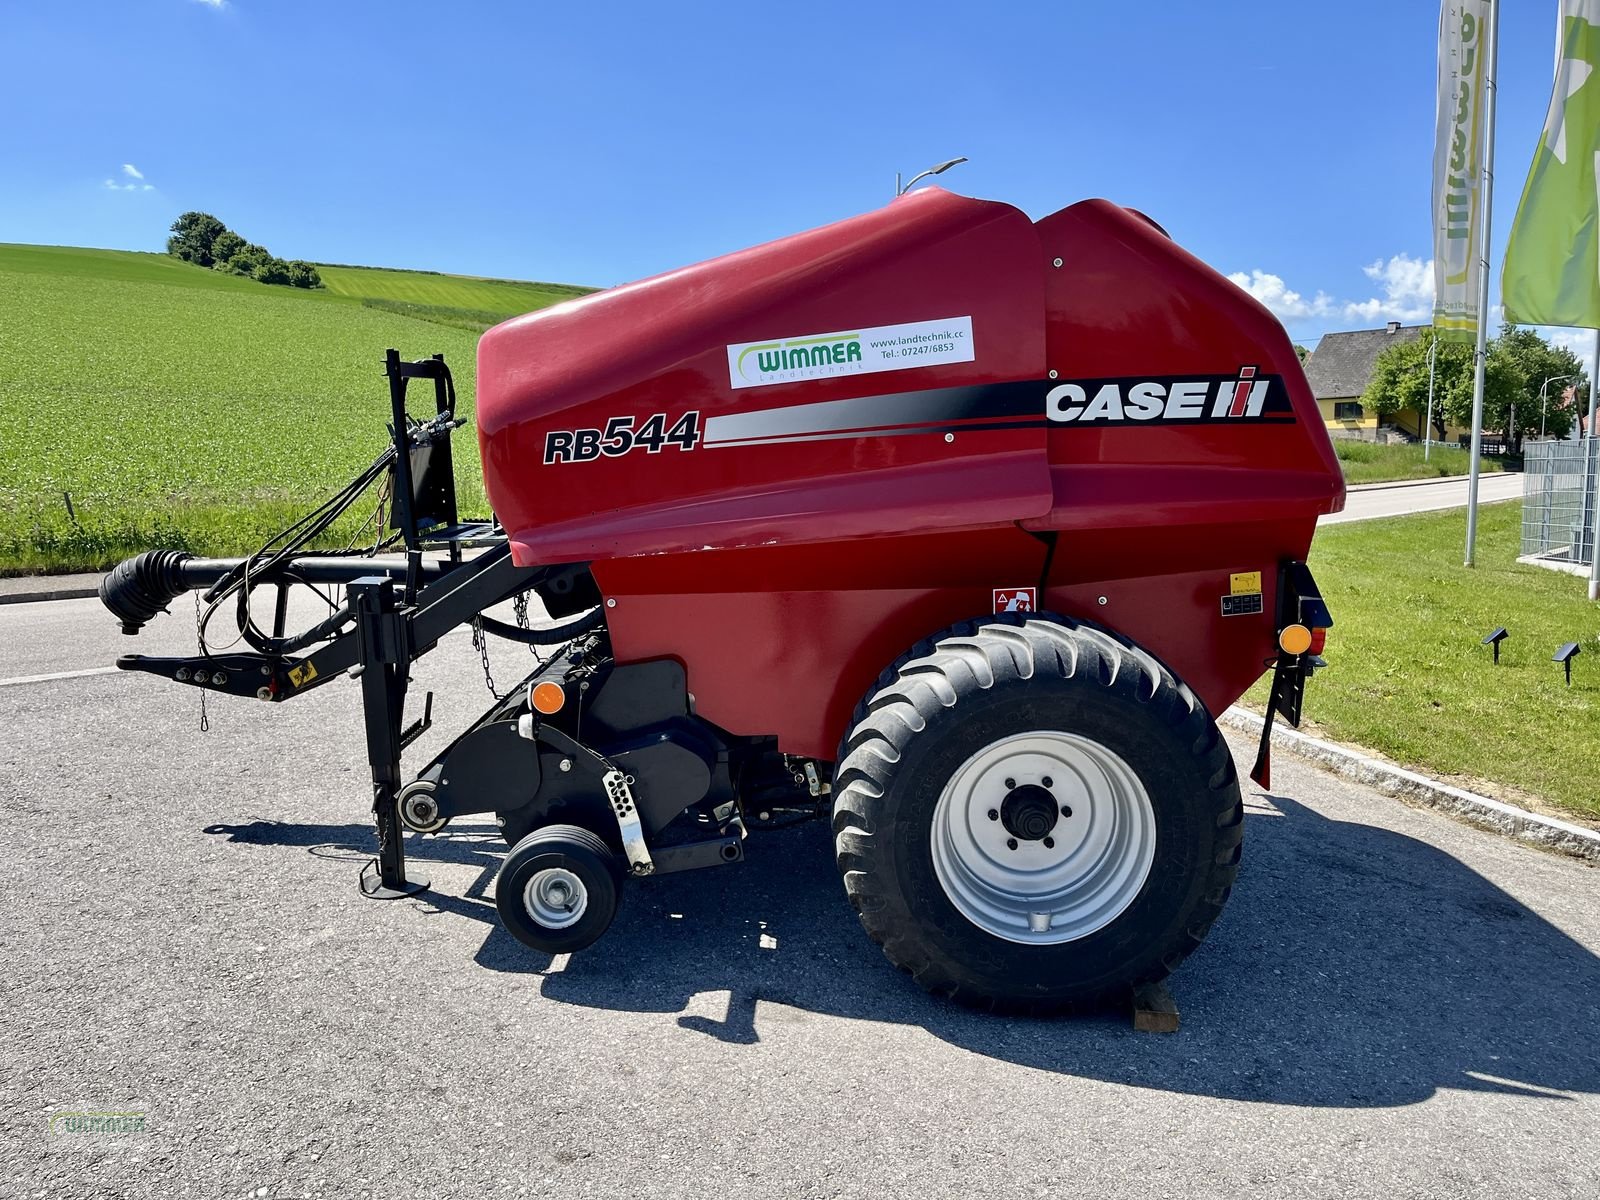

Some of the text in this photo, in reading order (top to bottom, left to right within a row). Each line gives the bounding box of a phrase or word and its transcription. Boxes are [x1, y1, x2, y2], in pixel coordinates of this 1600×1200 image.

[870, 331, 964, 349] www.landtechnik.cc
[881, 343, 954, 359] Tel.: 07247/6853
[758, 341, 862, 372] WIMMER
[760, 364, 863, 381] Landtechnik
[1046, 382, 1210, 422] CASE
[543, 410, 701, 465] RB544
